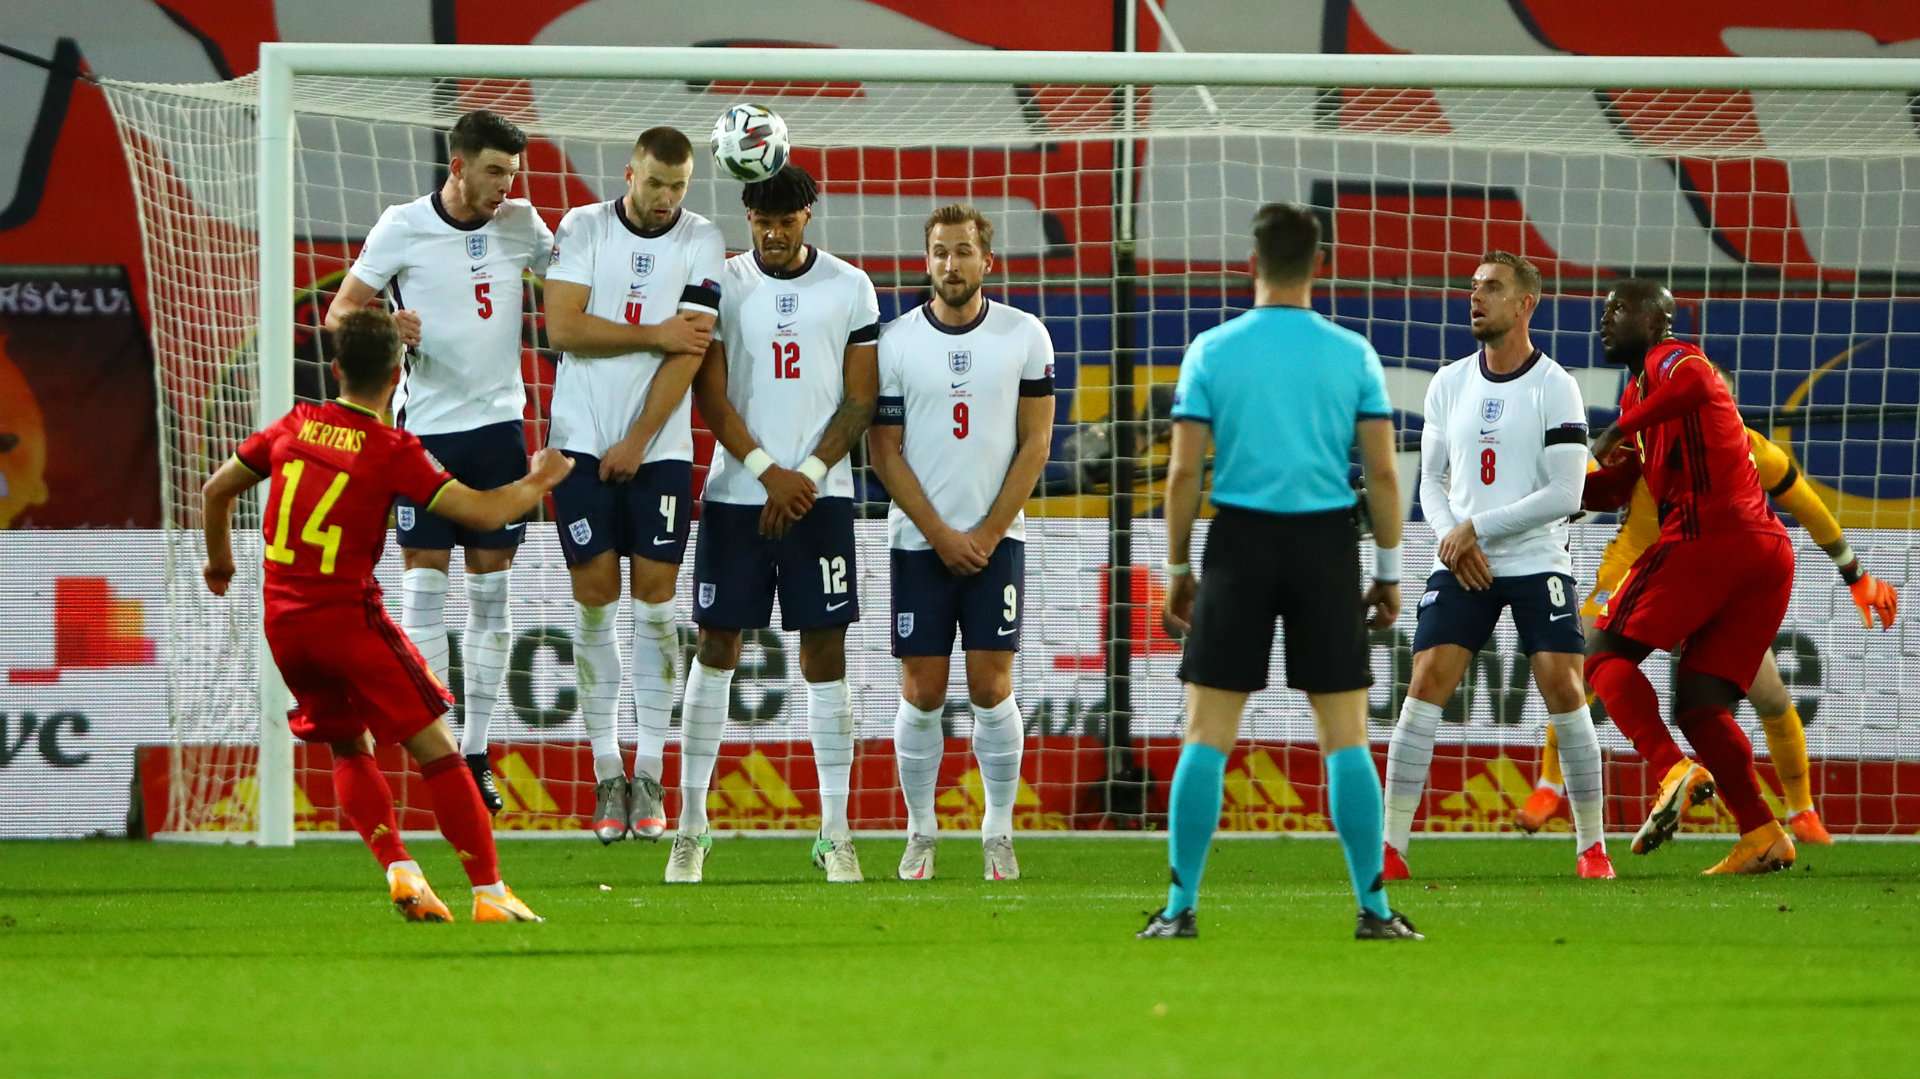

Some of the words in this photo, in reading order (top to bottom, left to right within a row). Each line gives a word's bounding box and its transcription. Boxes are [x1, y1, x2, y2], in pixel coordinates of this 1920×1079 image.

[475, 282, 493, 320] 5
[772, 341, 801, 379] 12
[298, 419, 367, 453] MERTENS
[953, 402, 969, 439] 9
[1480, 447, 1496, 486] 8
[265, 459, 350, 575] 14
[659, 494, 677, 533] 4
[819, 555, 848, 594] 12
[1546, 575, 1567, 608] 8
[1003, 584, 1017, 623] 9
[1217, 803, 1330, 832] didas
